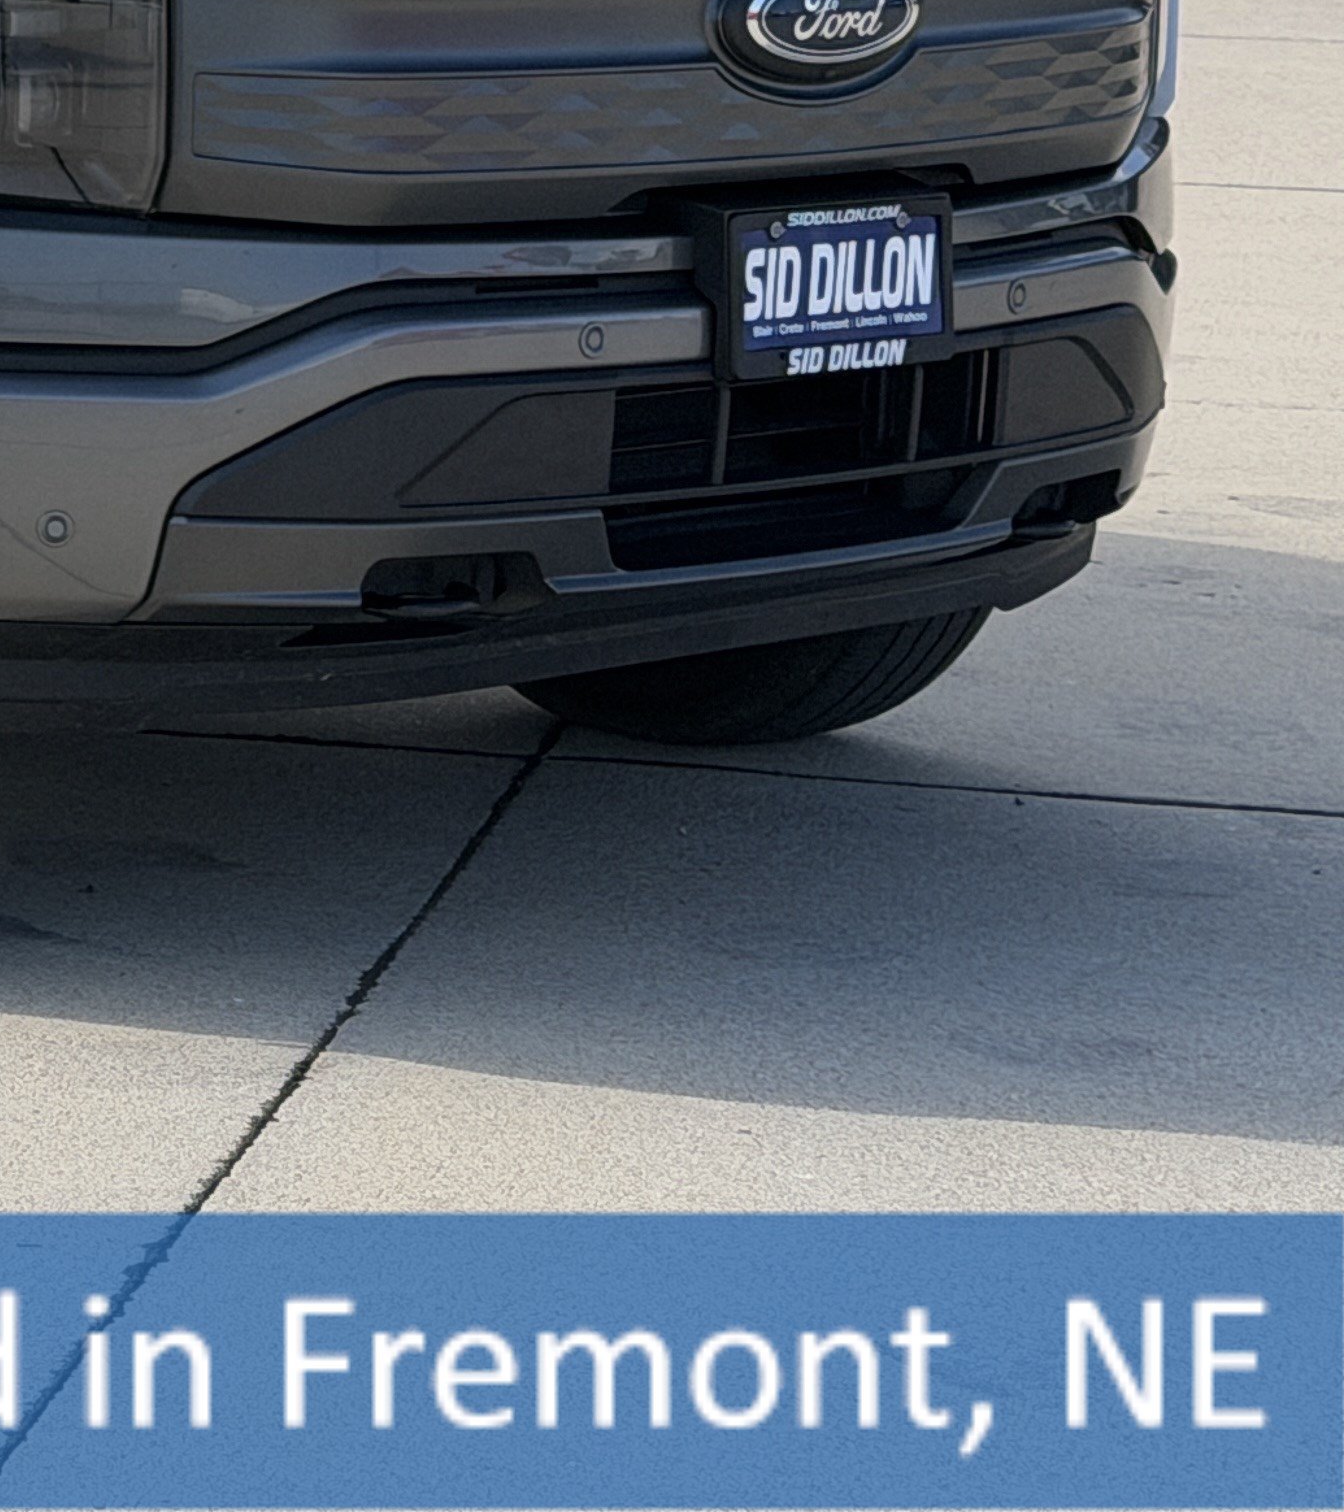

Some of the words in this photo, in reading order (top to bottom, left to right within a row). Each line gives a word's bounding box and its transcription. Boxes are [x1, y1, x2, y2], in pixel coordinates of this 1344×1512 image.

[787, 204, 901, 227] SIDDILLON.COM
[743, 246, 802, 321] SID
[808, 233, 936, 316] DILLON
[786, 347, 824, 376] SID
[827, 339, 907, 372] DILLON
